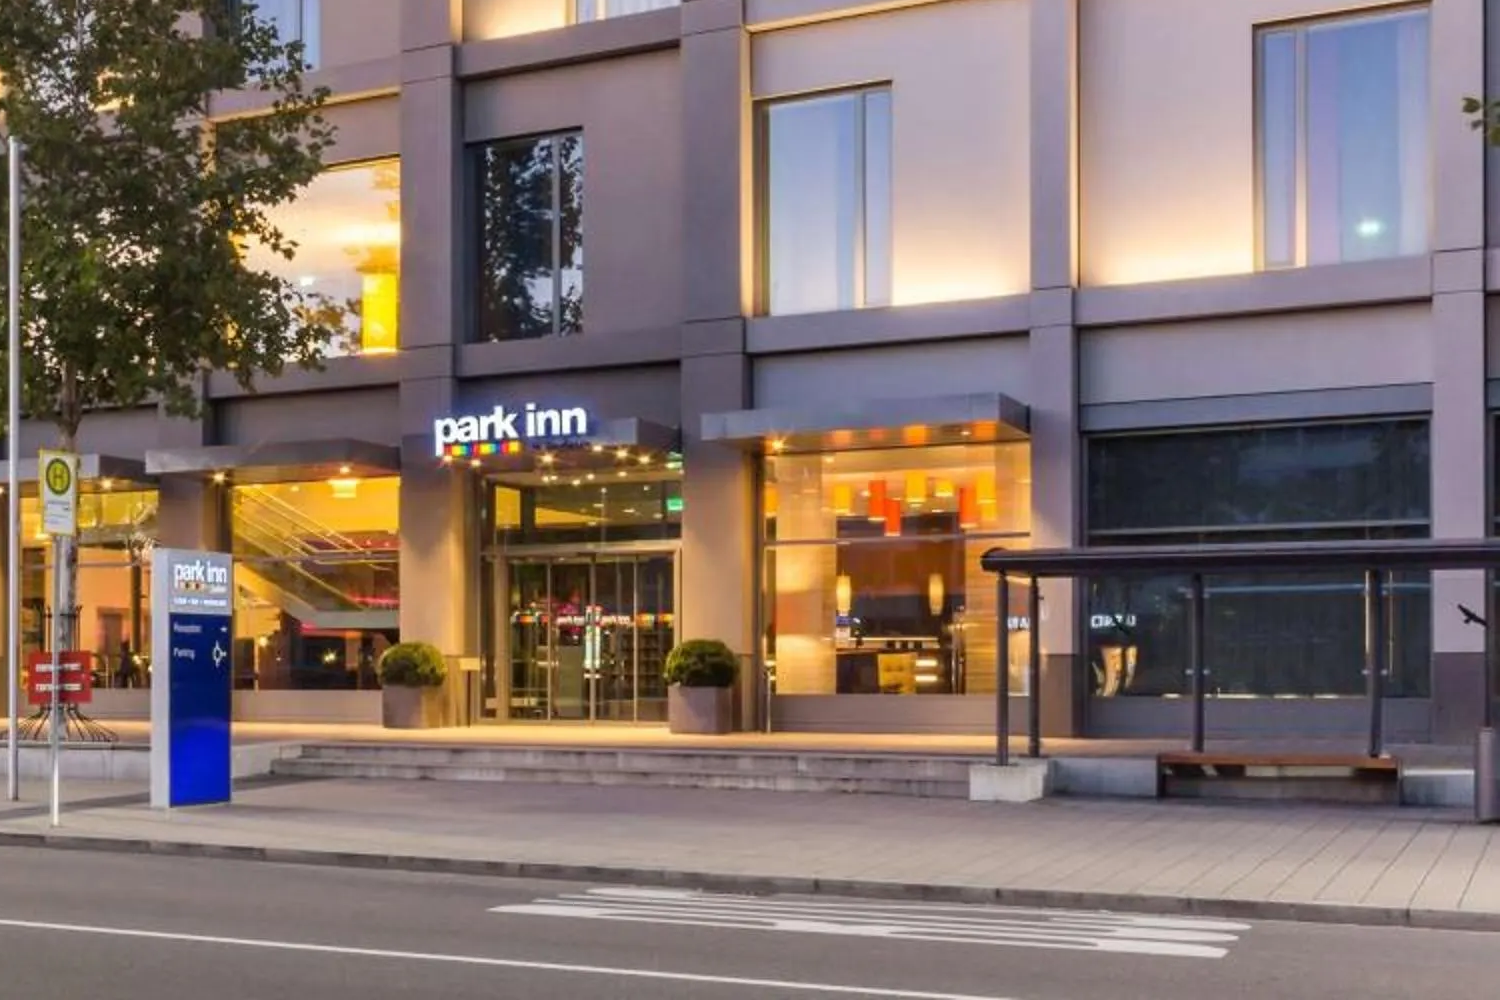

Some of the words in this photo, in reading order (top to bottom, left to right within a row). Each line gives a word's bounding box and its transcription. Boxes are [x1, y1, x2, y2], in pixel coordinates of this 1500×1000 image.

[434, 405, 519, 457] park
[526, 402, 587, 437] inn
[52, 465, 65, 488] H
[173, 559, 205, 589] park
[207, 560, 228, 584] inn
